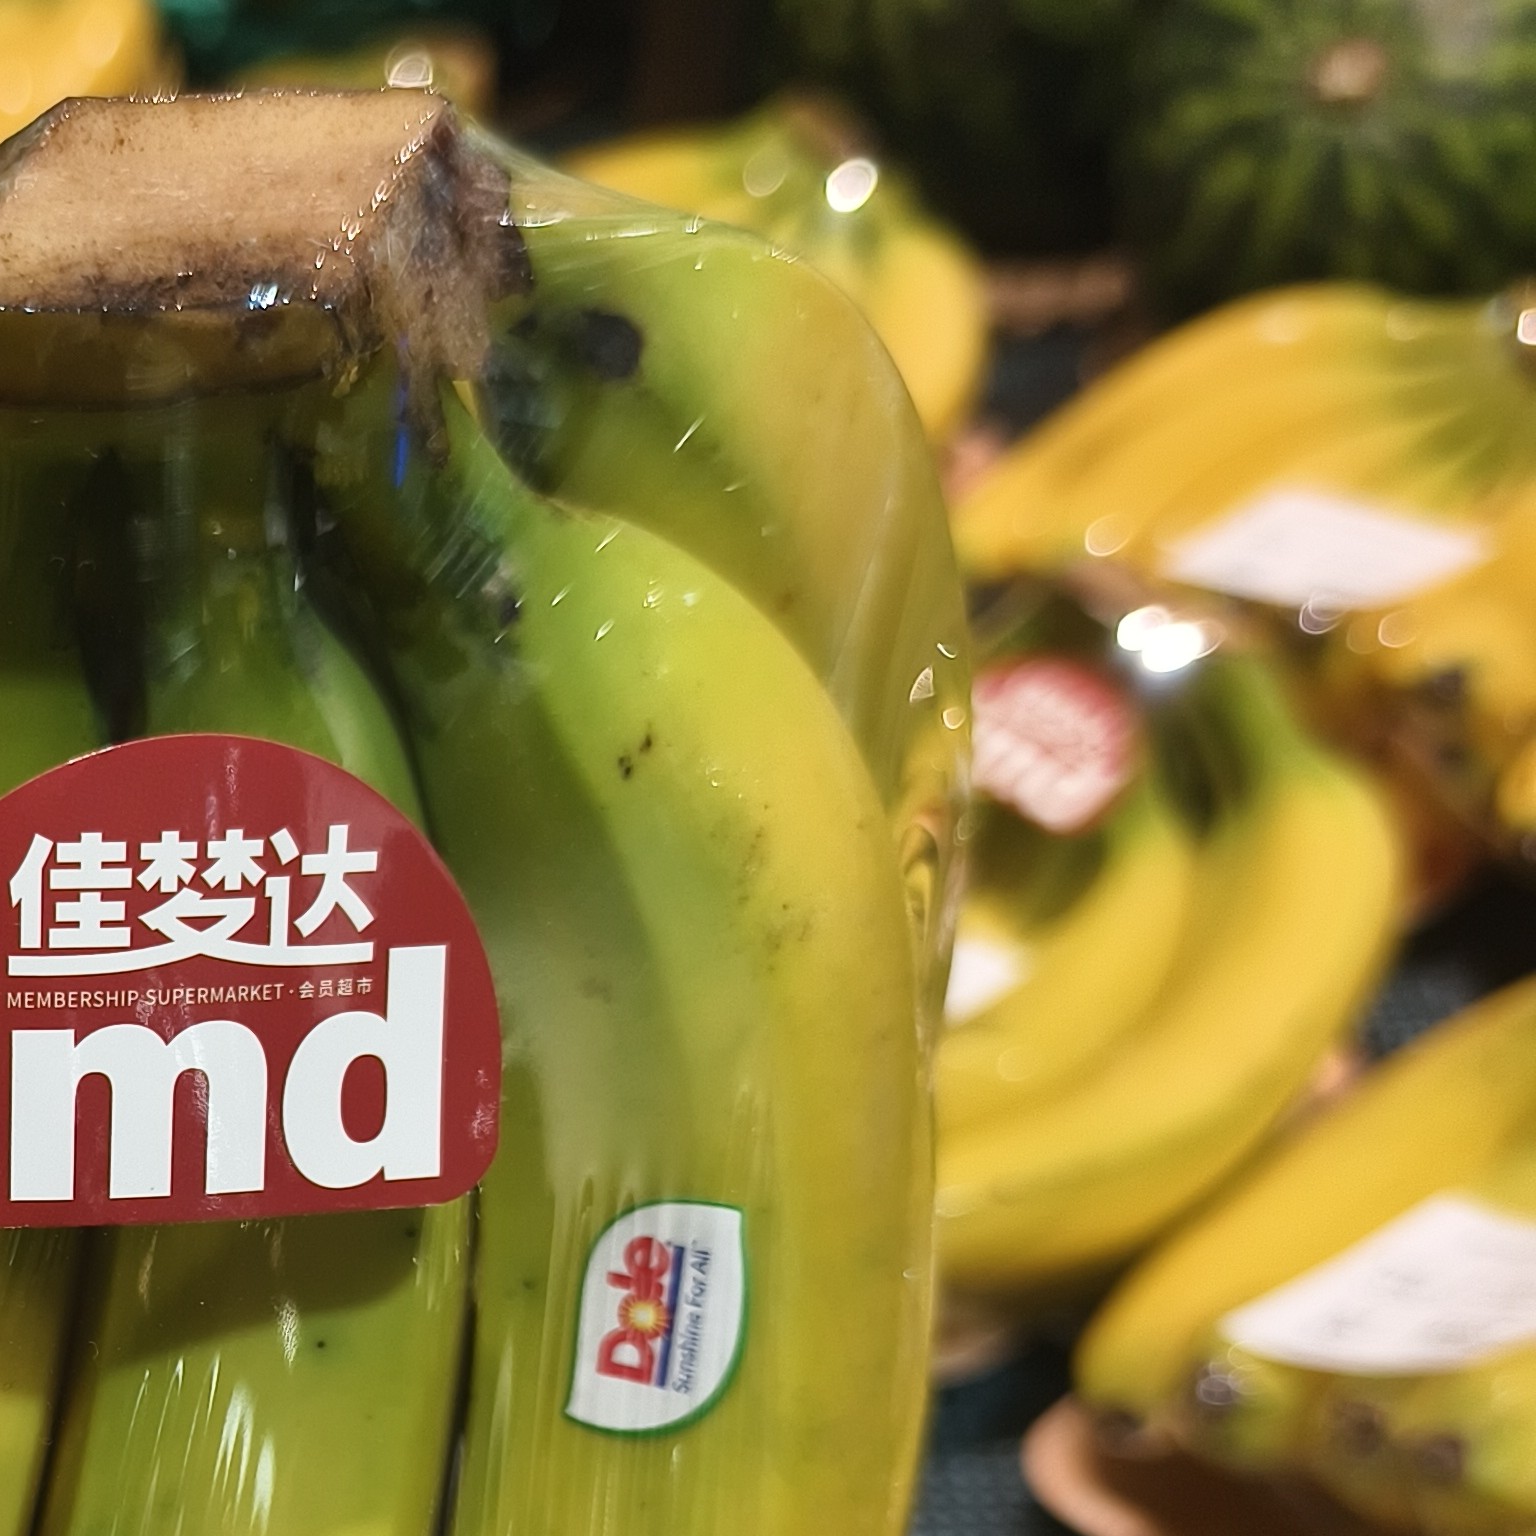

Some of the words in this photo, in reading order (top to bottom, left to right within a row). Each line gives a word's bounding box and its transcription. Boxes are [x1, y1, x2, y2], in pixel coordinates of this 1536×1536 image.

[8, 823, 379, 976] 佳梦达
[6, 989, 139, 1009] MEMBERSHIP
[143, 983, 285, 1006] SUPERMARKET
[297, 976, 373, 999] 会员超市
[692, 1249, 713, 1276] All
[594, 1235, 671, 1387] Dole
[684, 1276, 707, 1309] For
[671, 1311, 702, 1395] Sunshine
